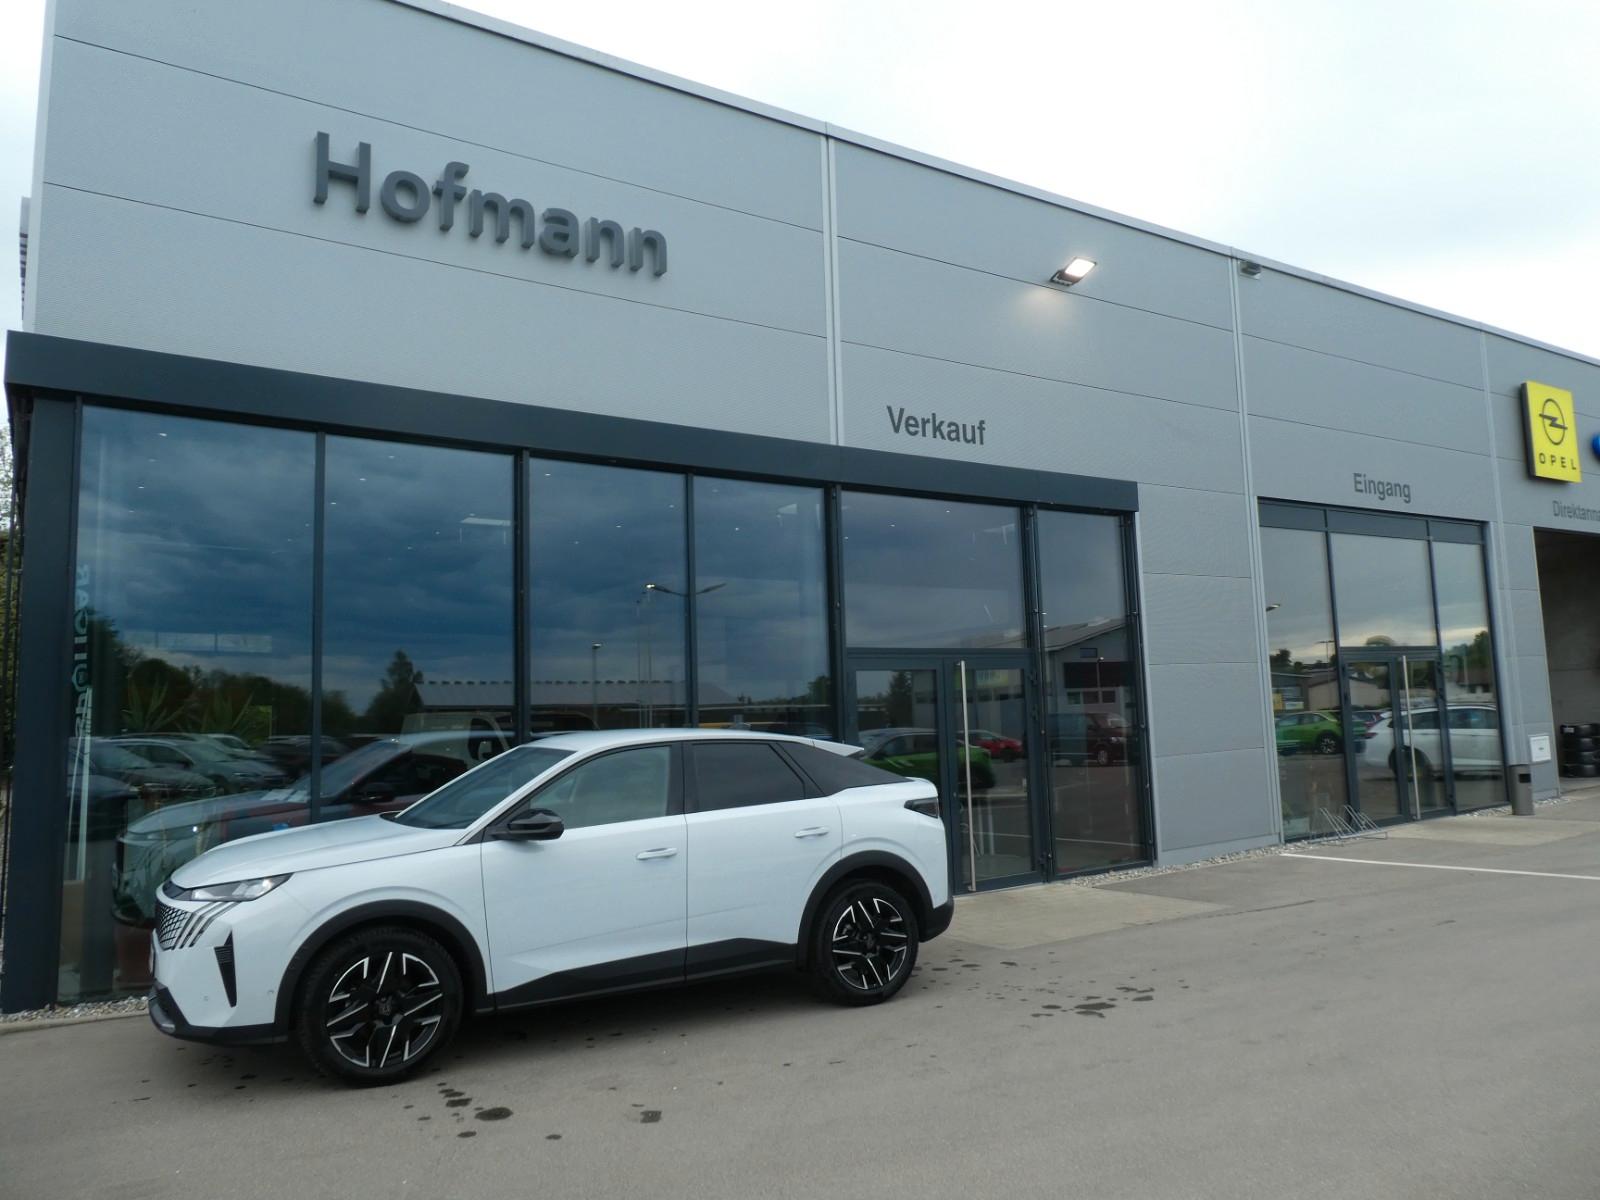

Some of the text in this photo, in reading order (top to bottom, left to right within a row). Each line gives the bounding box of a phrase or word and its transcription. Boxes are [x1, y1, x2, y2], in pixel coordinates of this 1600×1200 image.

[313, 131, 667, 277] Hofmann
[886, 404, 986, 445] Verkauf
[1538, 452, 1577, 471] OPEL
[1353, 472, 1411, 504] Eingang
